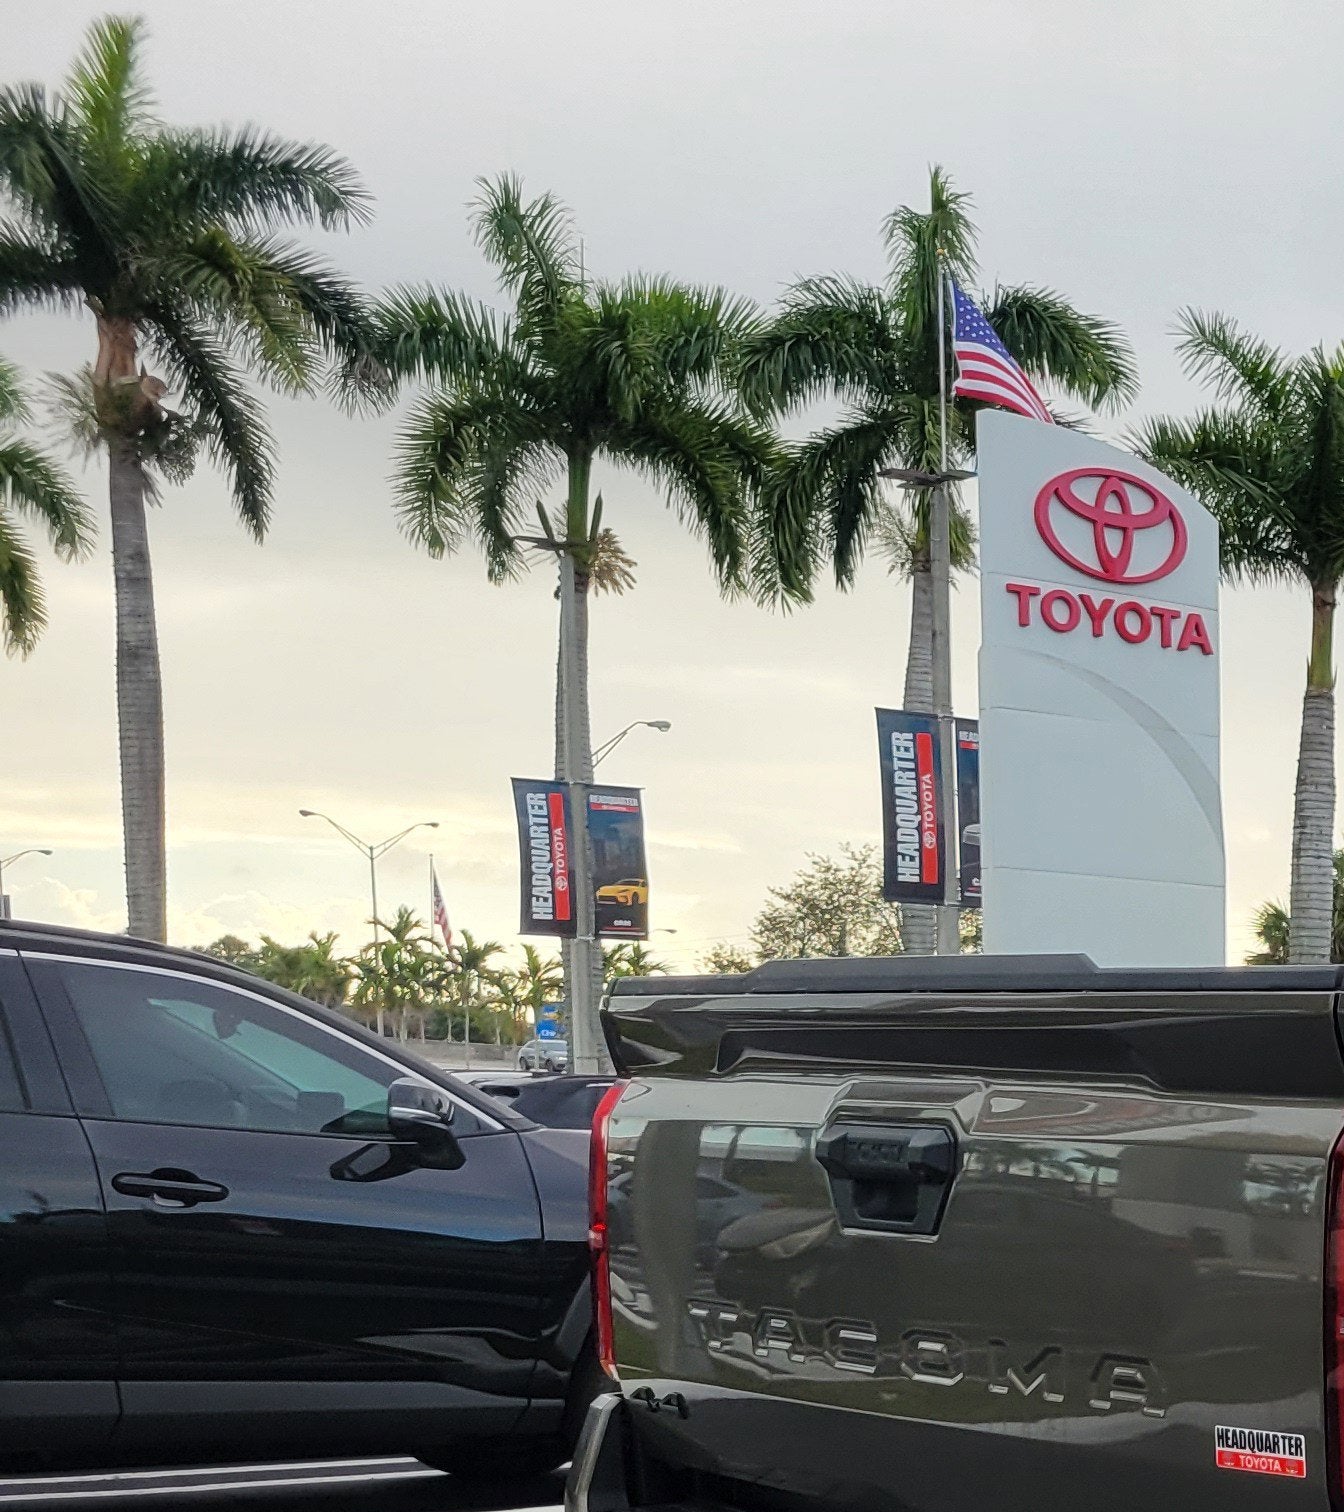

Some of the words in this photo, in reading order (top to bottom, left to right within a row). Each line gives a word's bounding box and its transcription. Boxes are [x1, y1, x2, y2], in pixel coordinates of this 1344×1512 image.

[1006, 583, 1213, 655] TOYOTA
[891, 731, 921, 883] HEADQUARTER
[922, 774, 936, 829] TOYOTA
[526, 793, 553, 920] HEADQUARTER
[553, 827, 566, 876] TOYOTA
[689, 1299, 1167, 1418] TACOMA
[1216, 1427, 1303, 1457] HEADQUARTER
[1238, 1454, 1282, 1472] TOYOTA
